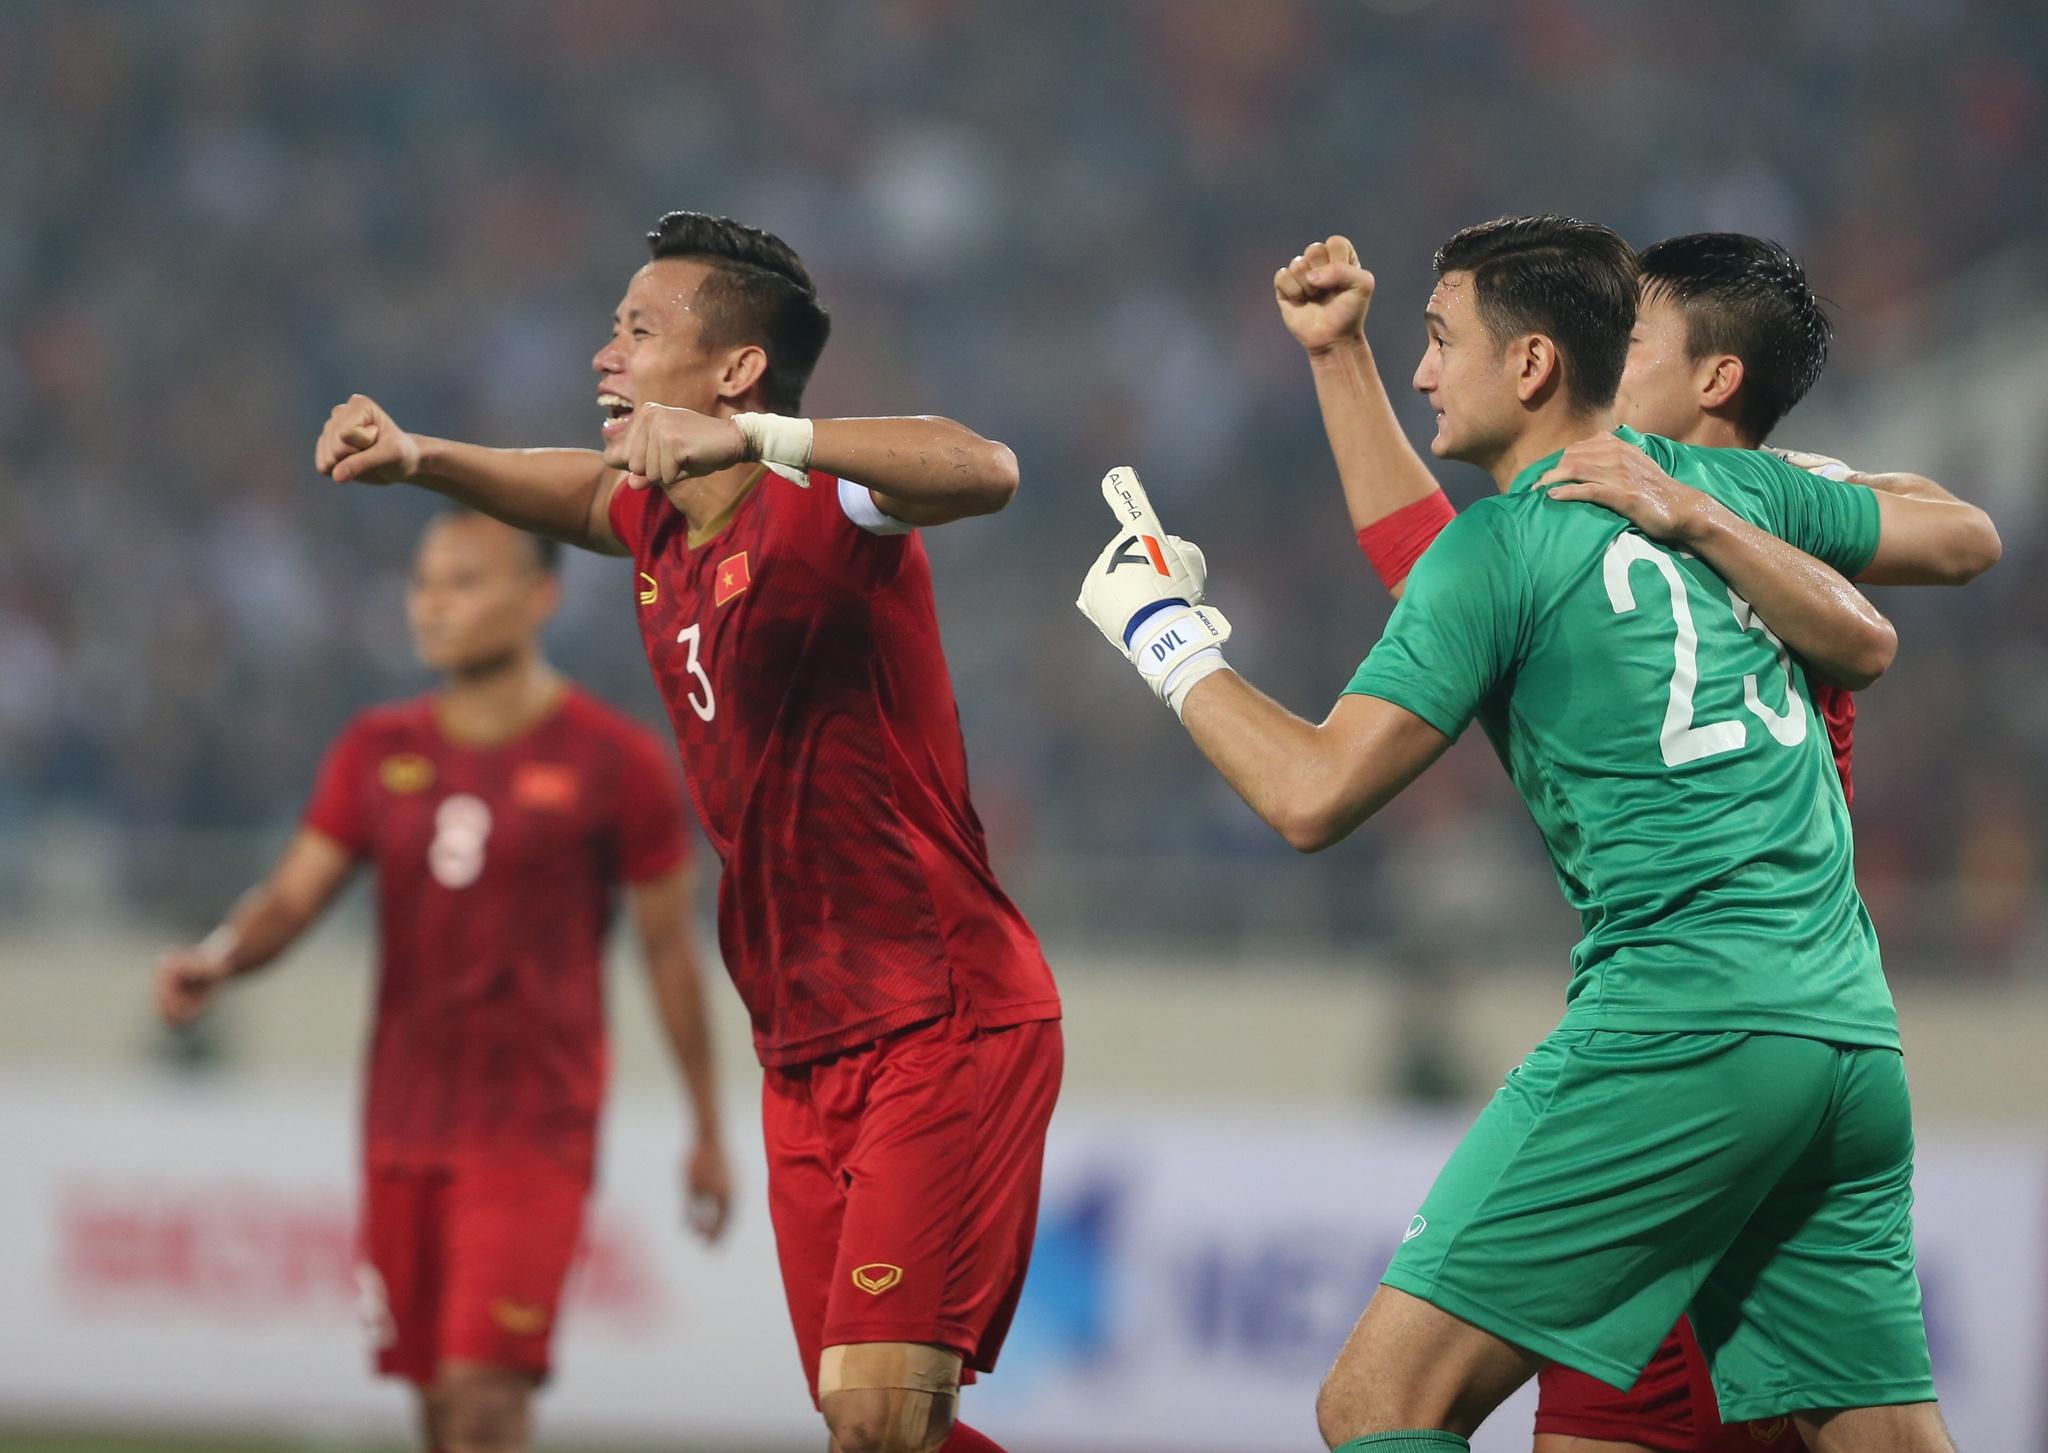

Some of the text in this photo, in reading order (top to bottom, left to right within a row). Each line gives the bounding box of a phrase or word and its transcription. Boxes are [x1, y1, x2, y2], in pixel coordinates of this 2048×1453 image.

[1108, 473, 1142, 521] ALPHA
[1194, 609, 1218, 636] EXTREME
[1151, 630, 1187, 662] DVL
[677, 623, 716, 722] 3
